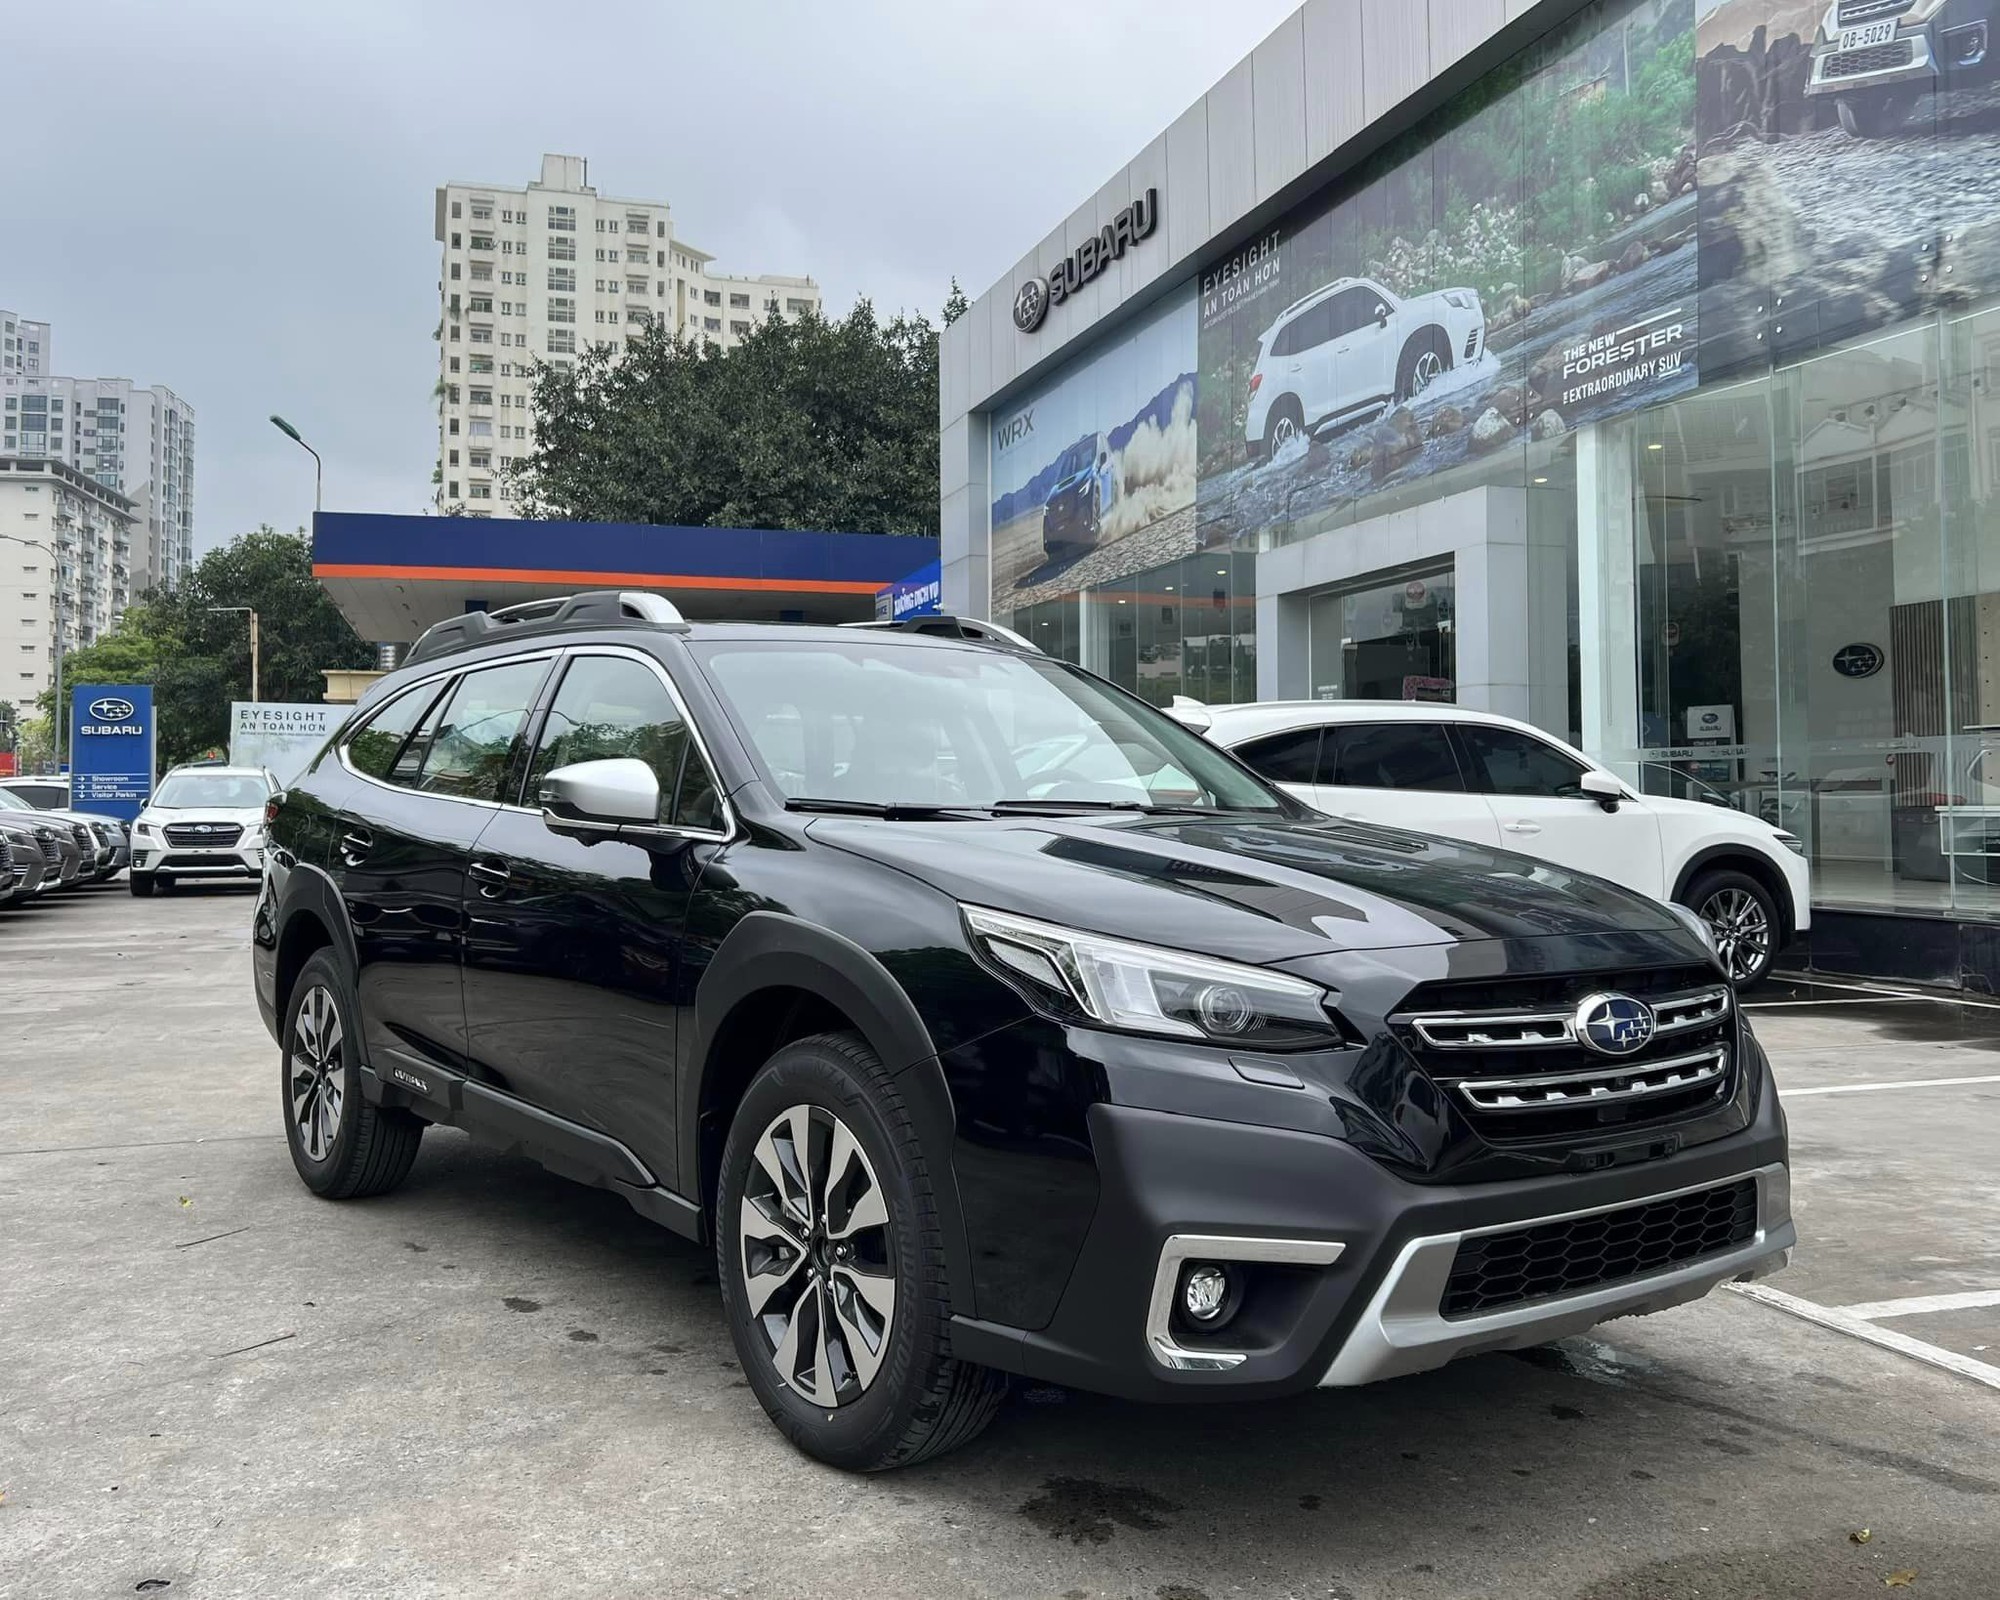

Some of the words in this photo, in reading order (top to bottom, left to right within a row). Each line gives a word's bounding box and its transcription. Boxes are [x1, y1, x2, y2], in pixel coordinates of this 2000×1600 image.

[1049, 187, 1157, 307] SUBARU
[1203, 230, 1280, 298] EYESIGHT
[1203, 297, 1218, 319] AN
[1222, 277, 1250, 307] TOÀN
[1254, 257, 1280, 287] HƠN
[1562, 343, 1587, 363] THE
[1588, 331, 1616, 355] NEW
[1562, 324, 1683, 380] FORESTER
[1569, 360, 1656, 404] EXTRAORDINARY
[1658, 351, 1682, 374] SUV
[997, 407, 1036, 451] WRX
[80, 725, 143, 736] SUBARU
[240, 709, 326, 721] EYESIGHT
[240, 722, 257, 731] AN
[262, 722, 294, 732] TOÀN
[299, 723, 326, 733] HƠN
[1660, 749, 1694, 758] SUBARU
